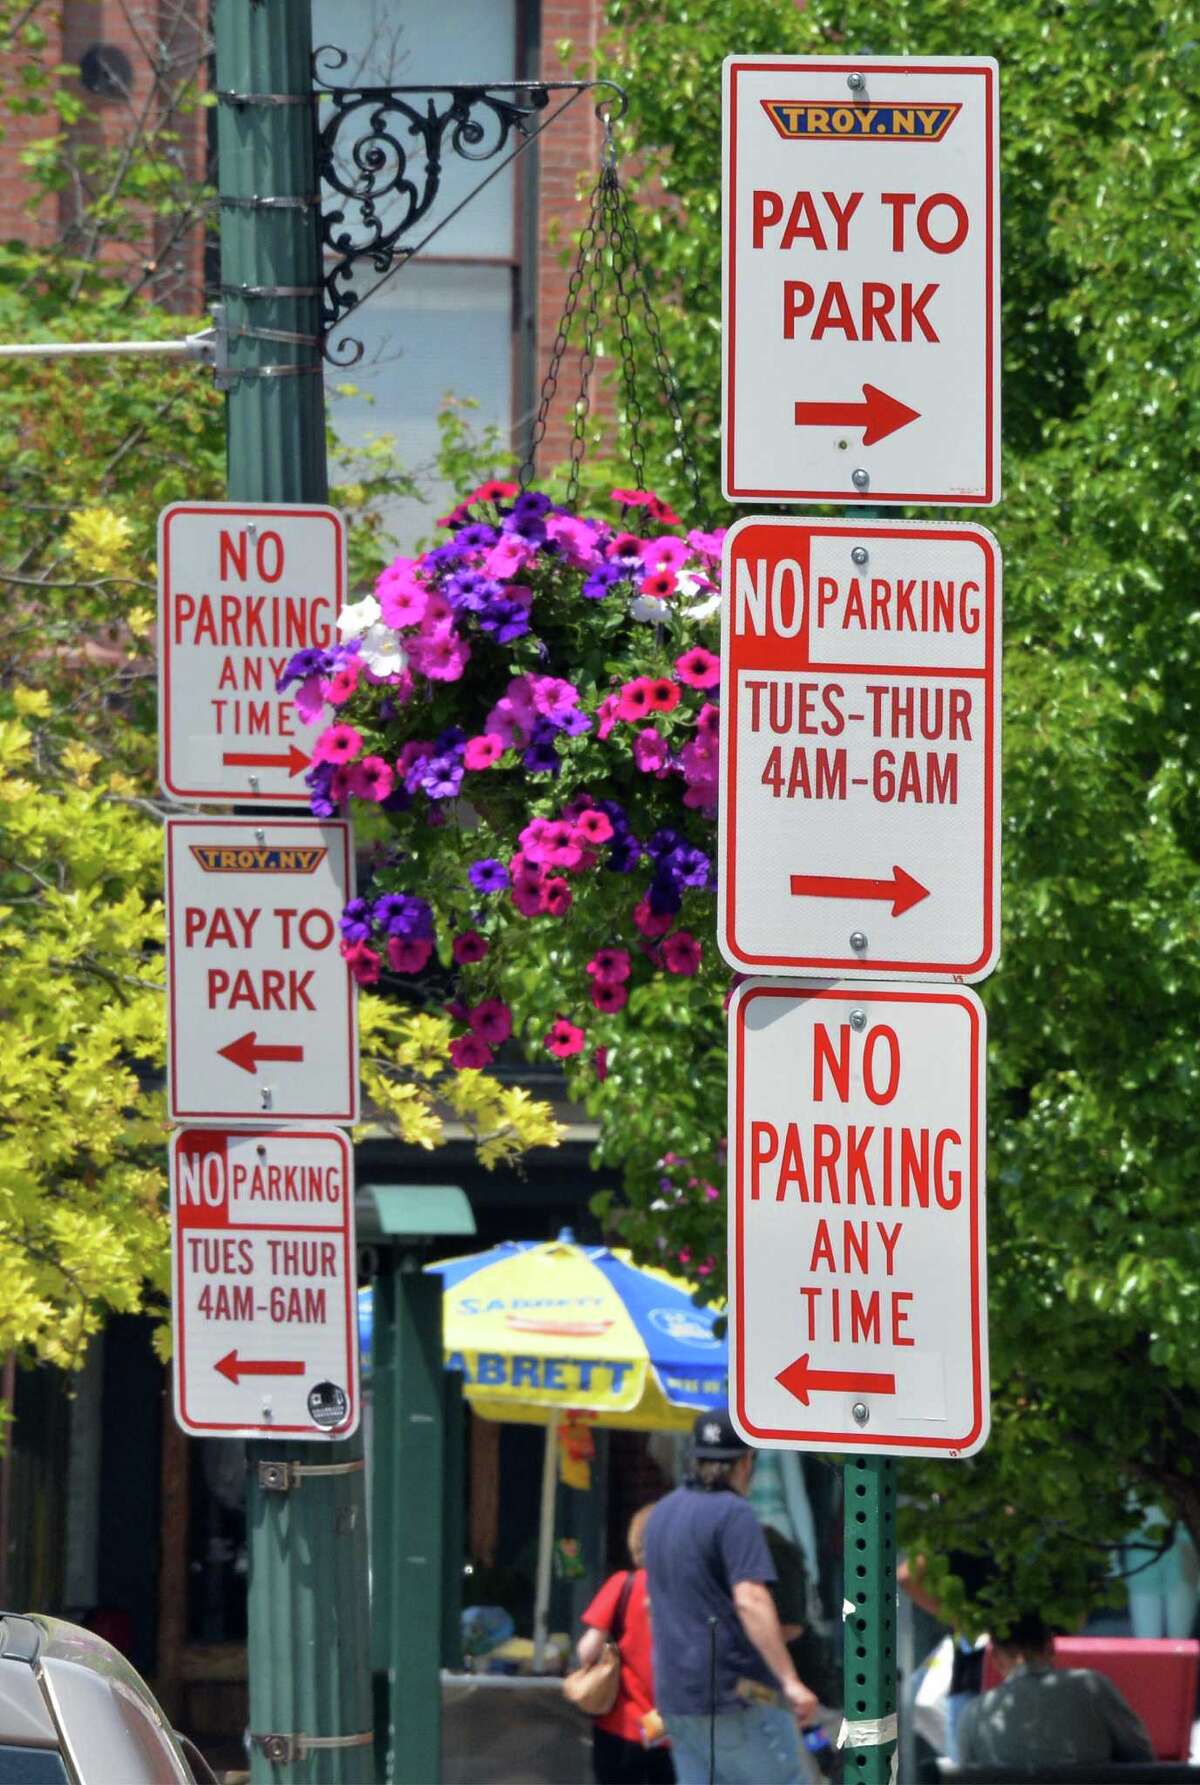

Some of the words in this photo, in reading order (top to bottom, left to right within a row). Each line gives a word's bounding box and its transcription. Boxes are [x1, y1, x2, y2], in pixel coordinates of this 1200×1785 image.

[782, 108, 941, 134] TROY.NY
[752, 190, 864, 251] PAY
[881, 192, 969, 255] TO
[783, 280, 940, 343] PARK
[219, 530, 285, 583] NO
[175, 594, 331, 648] PARKING
[735, 558, 804, 639] NO
[817, 576, 981, 635] PARKING
[218, 656, 287, 691] ANY
[211, 700, 295, 737] TIME
[745, 681, 973, 742] TUES-THUR
[761, 746, 958, 805] 4AM-6AM
[202, 849, 313, 869] TROY.NY
[185, 907, 262, 949] PAY
[273, 908, 335, 950] TO
[208, 969, 316, 1011] PARK
[812, 1023, 901, 1106] NO
[178, 1151, 225, 1207] NO
[233, 1164, 341, 1204] PARKING
[751, 1121, 962, 1211] PARKING
[188, 1237, 254, 1275] TUES
[267, 1240, 337, 1278] THUR
[809, 1219, 903, 1276] ANY
[198, 1284, 327, 1324] 4AM-6AM
[800, 1287, 915, 1347] TIME
[443, 1351, 633, 1394] ABRETT
